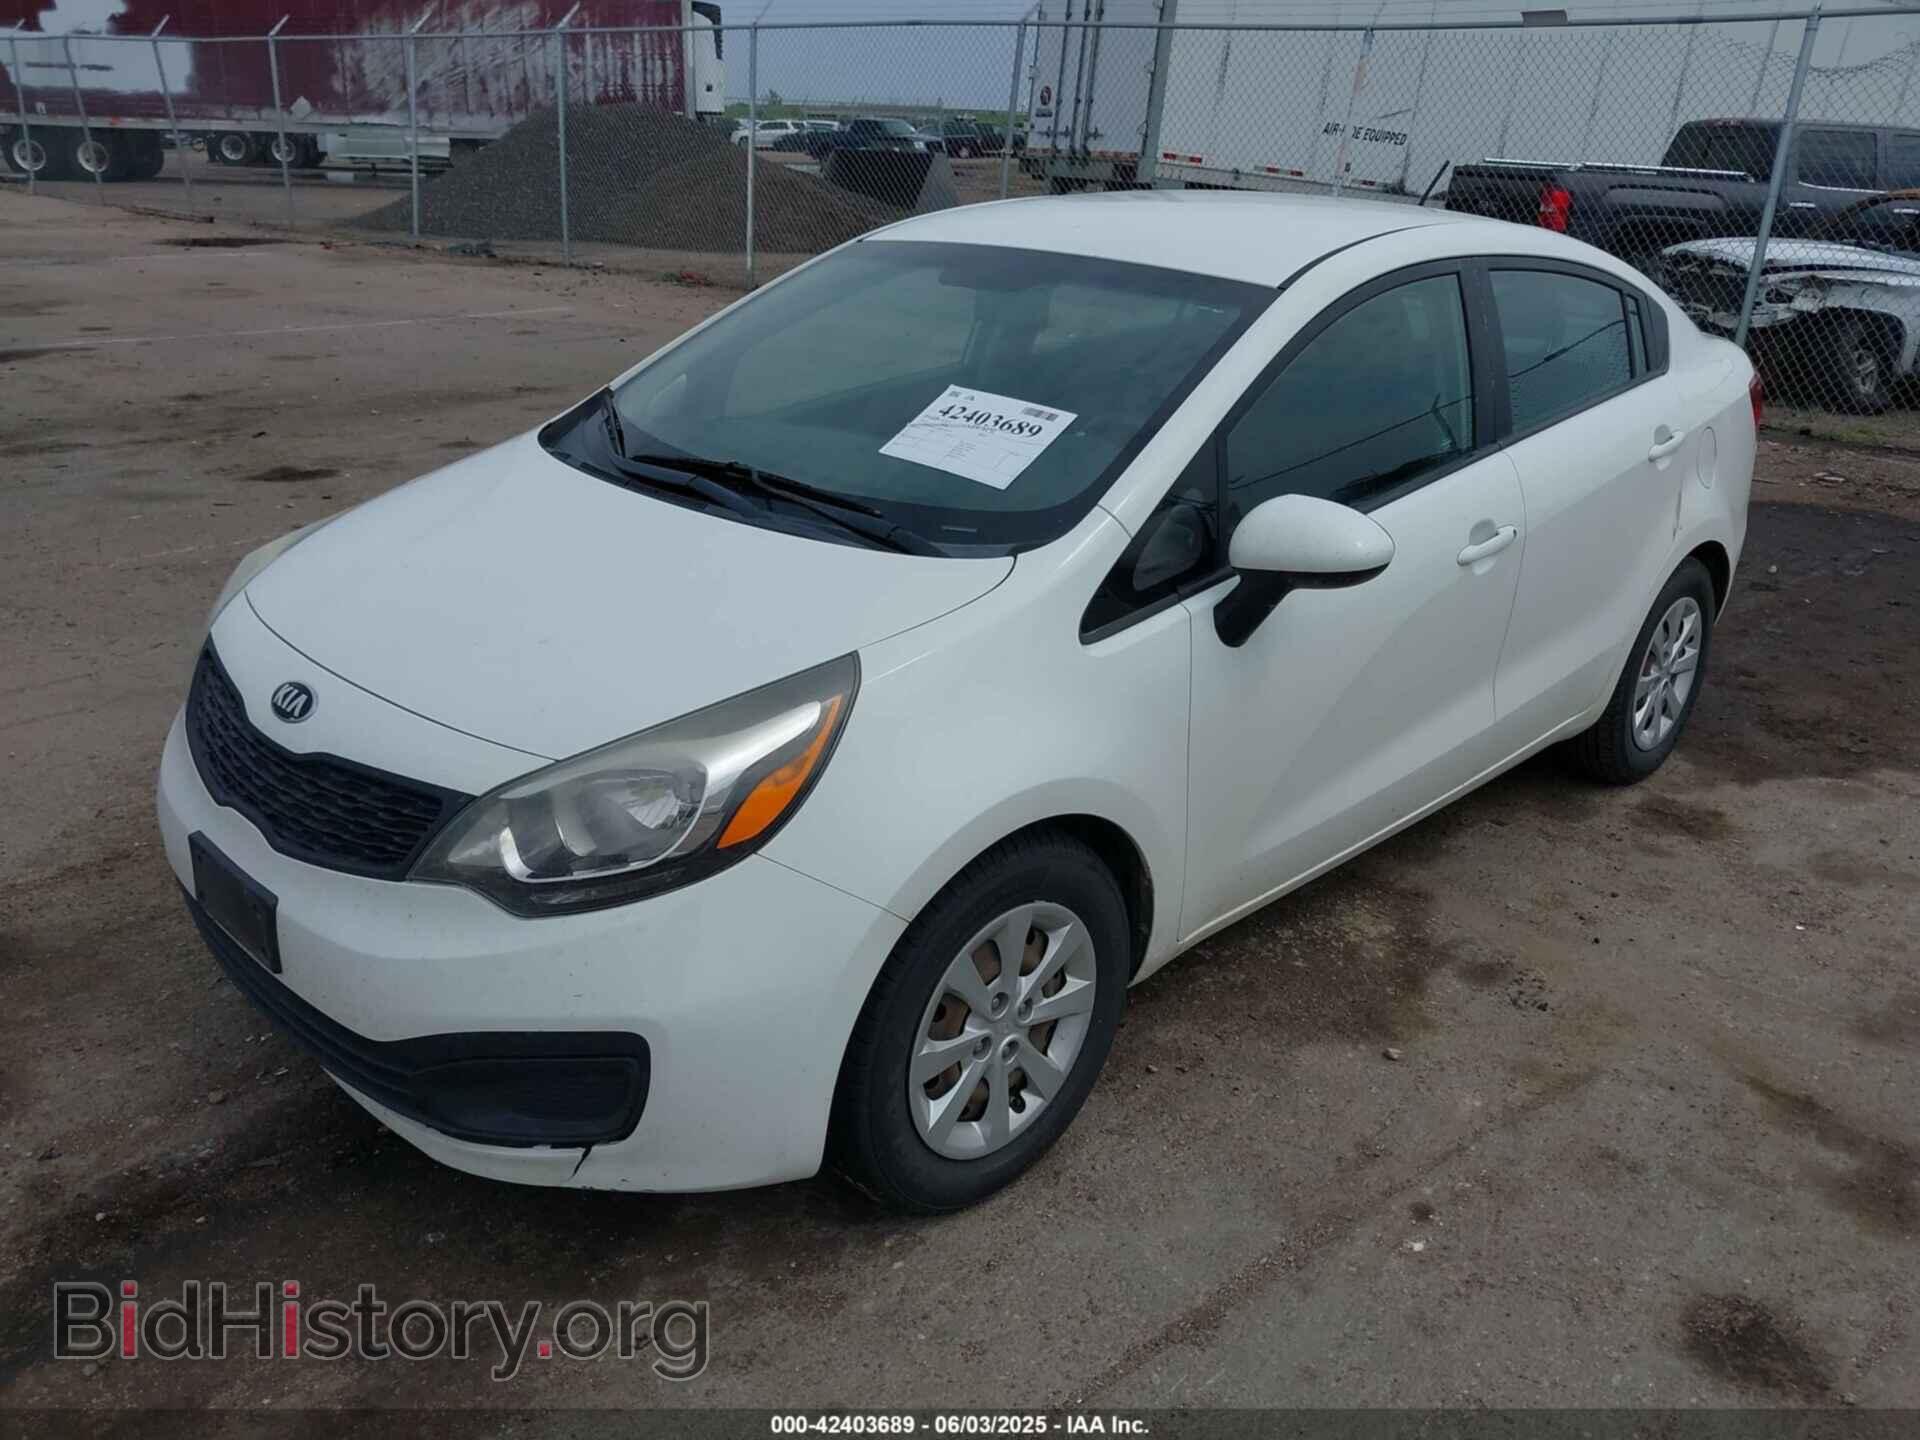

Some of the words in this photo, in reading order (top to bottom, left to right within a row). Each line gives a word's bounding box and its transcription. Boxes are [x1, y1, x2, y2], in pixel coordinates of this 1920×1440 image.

[1321, 121, 1363, 140] AIR-DE
[1363, 128, 1408, 146] EQUIPPED
[939, 404, 1043, 438] 42403689
[272, 683, 308, 717] KIA
